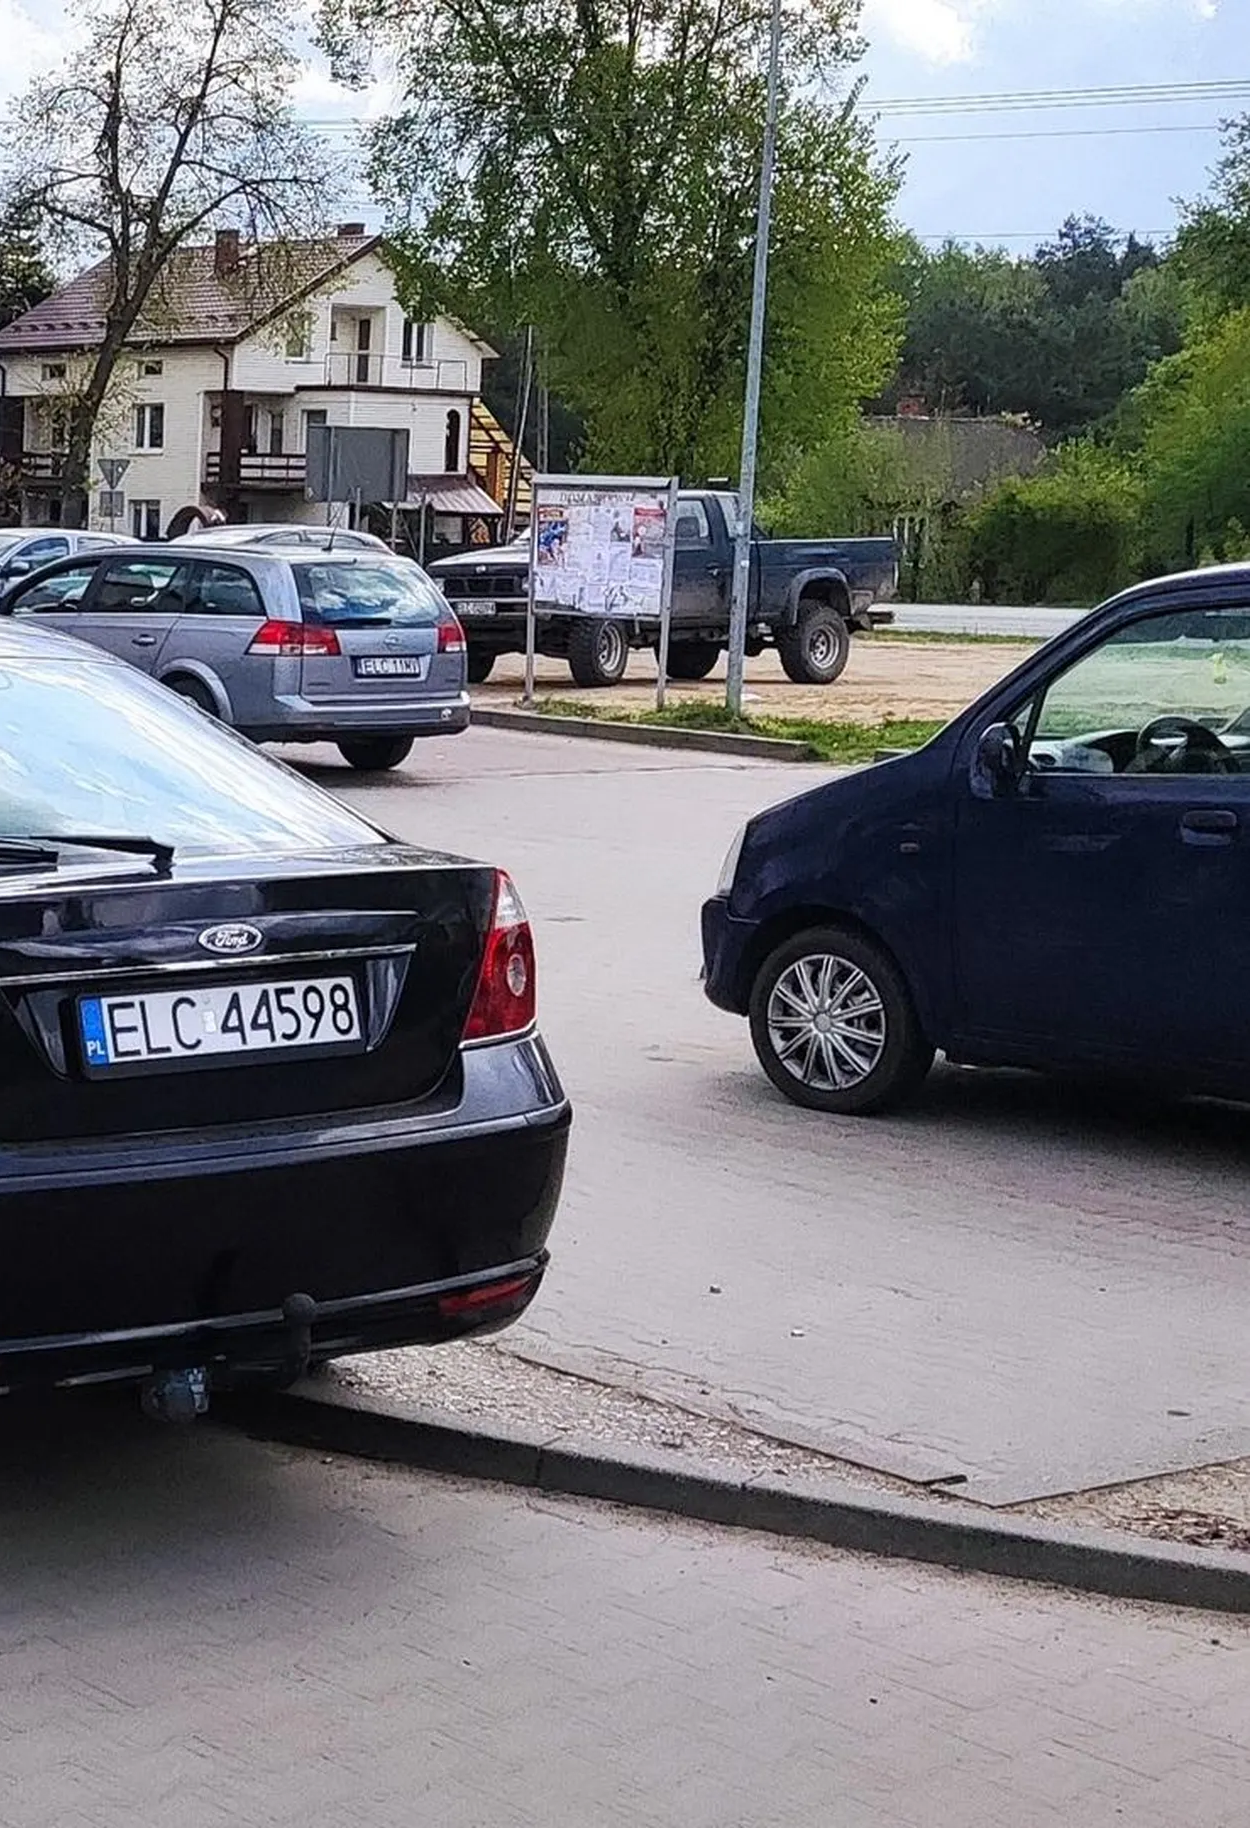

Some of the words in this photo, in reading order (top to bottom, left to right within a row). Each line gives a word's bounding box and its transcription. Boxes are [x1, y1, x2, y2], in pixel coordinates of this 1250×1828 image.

[106, 996, 203, 1058] ELC
[220, 983, 355, 1046] 44598
[85, 1039, 106, 1057] PL
